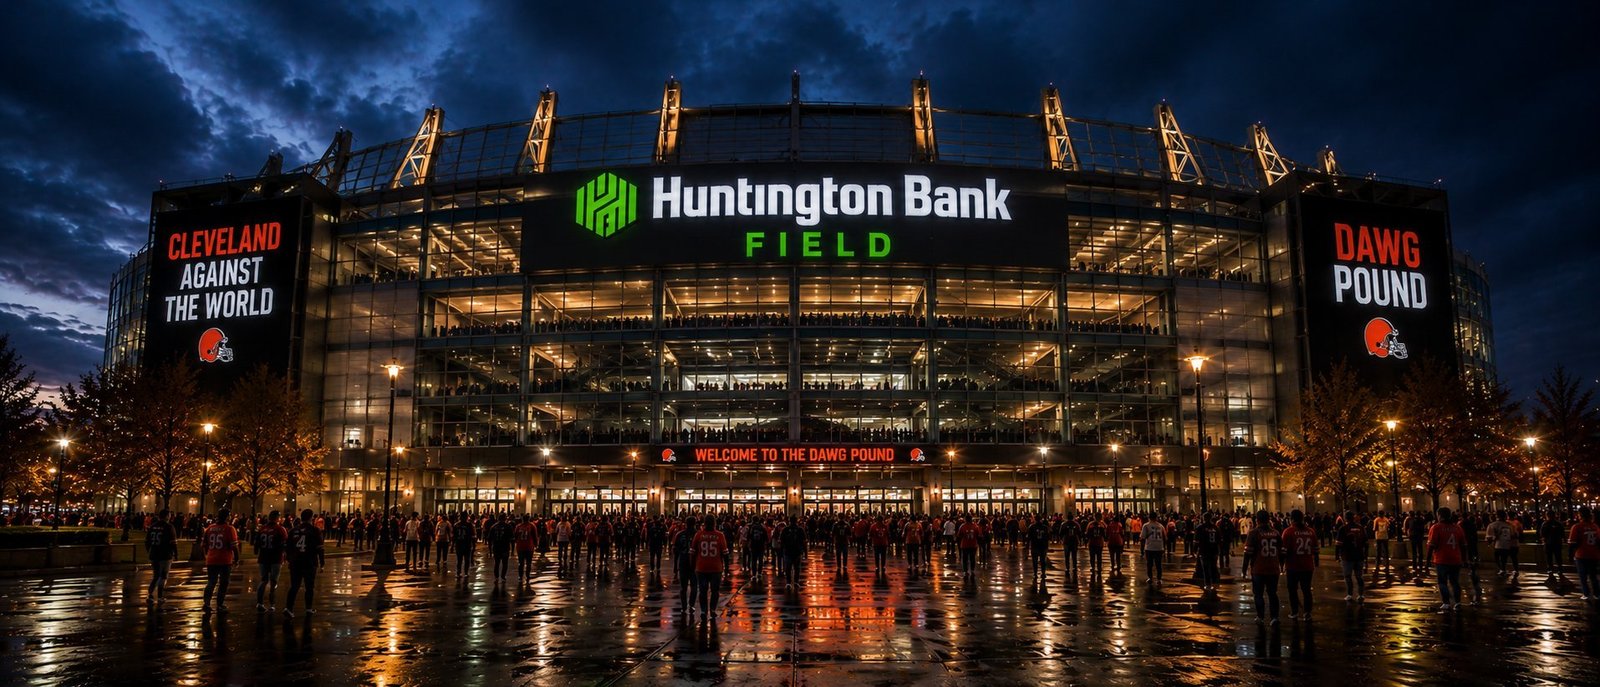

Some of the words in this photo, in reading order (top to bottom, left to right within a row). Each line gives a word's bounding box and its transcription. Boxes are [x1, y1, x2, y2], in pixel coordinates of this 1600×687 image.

[652, 176, 893, 227] Huntington
[904, 174, 1012, 221] Bank
[168, 222, 281, 261] CLEVELAND
[746, 231, 892, 258] FIELD
[1334, 222, 1421, 268] DAWG
[179, 256, 264, 291] AGAINST
[1333, 264, 1428, 310] POUND
[165, 294, 198, 322] THE
[205, 287, 274, 319] WORLD
[695, 448, 758, 462] WELCOME
[761, 448, 778, 462] TO
[782, 448, 806, 461] THE
[809, 448, 847, 462] DAWG
[851, 448, 895, 462] POUND
[209, 533, 224, 550] 95
[700, 540, 718, 557] 85
[1295, 538, 1312, 555] 24
[1447, 533, 1458, 550] 4
